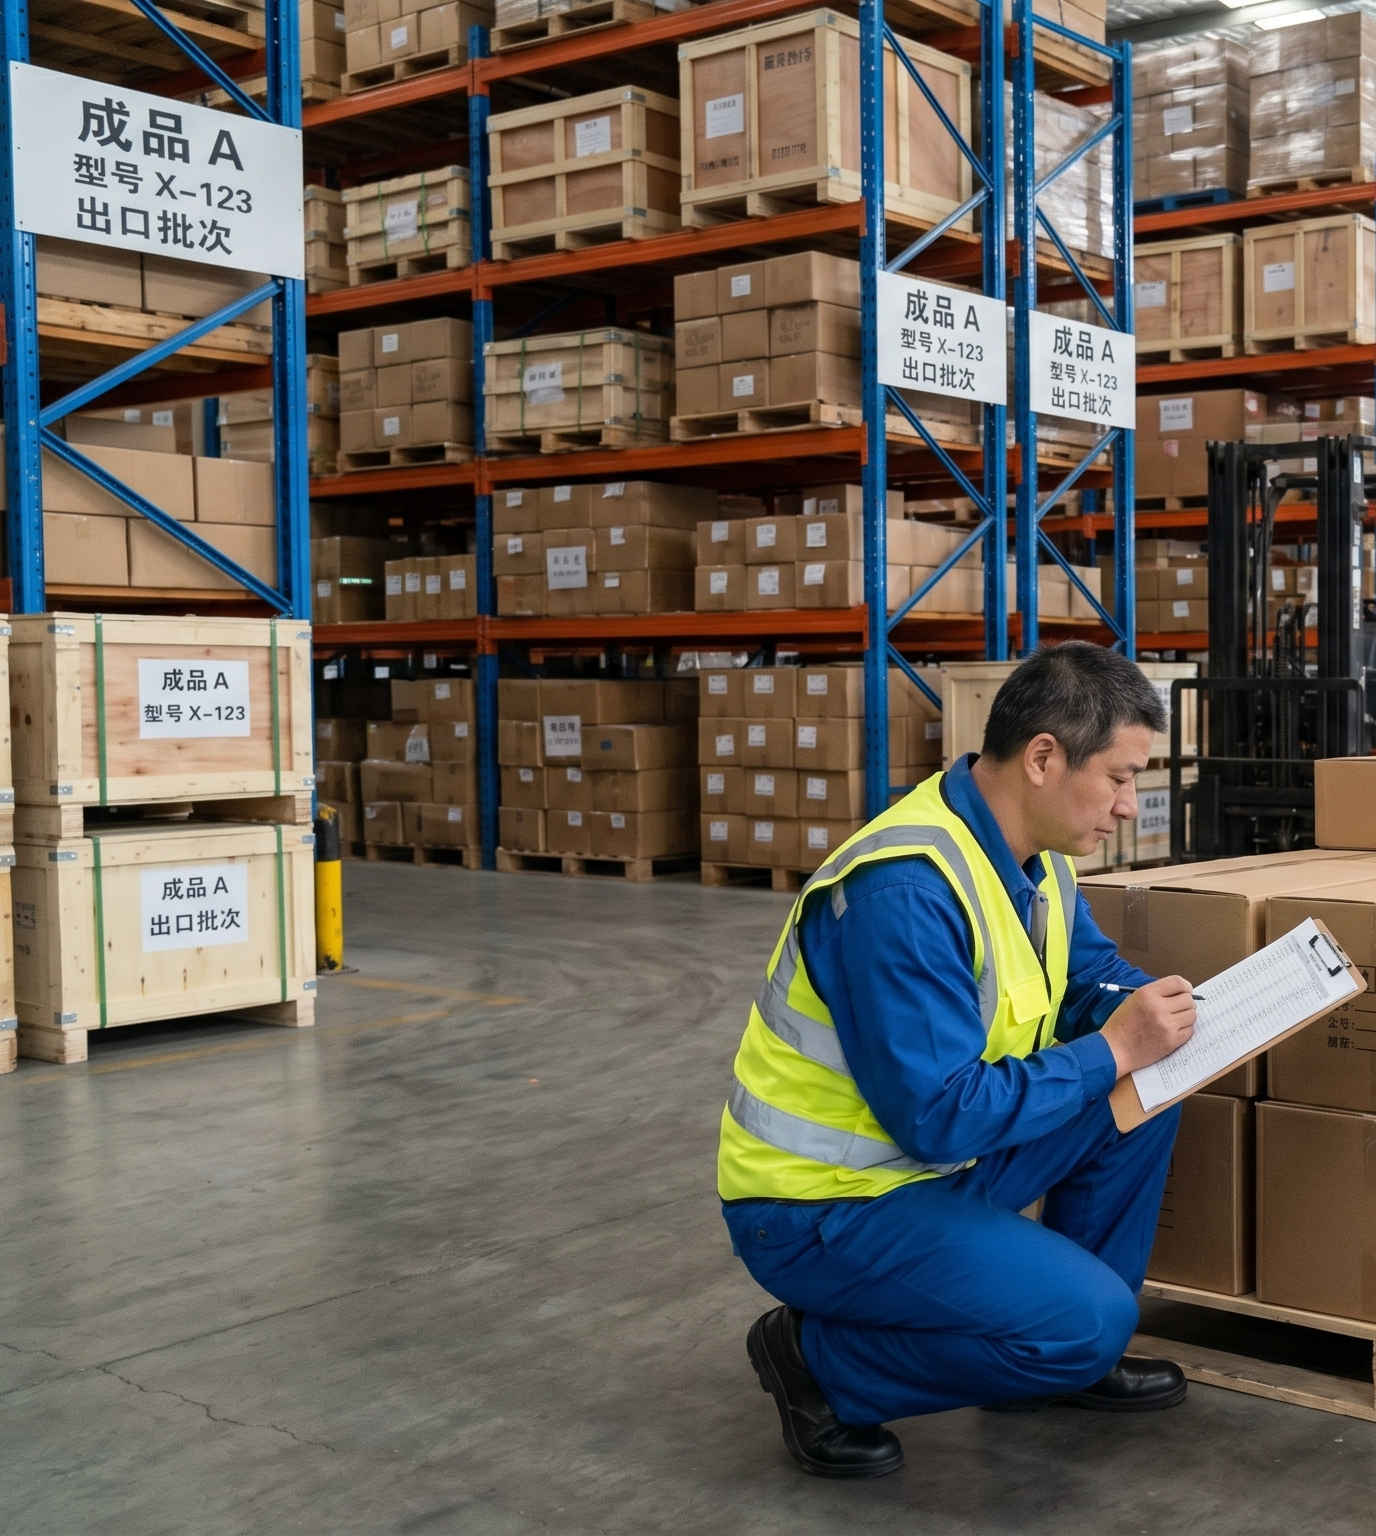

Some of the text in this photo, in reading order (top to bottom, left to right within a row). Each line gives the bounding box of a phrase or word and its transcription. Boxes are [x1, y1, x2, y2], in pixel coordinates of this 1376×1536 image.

[77, 97, 245, 172] 成品 A
[73, 153, 253, 214] 型号 X-123
[76, 196, 233, 256] 出口批次
[904, 289, 981, 332] 成品 A
[900, 328, 984, 362] 型号 X-123
[1053, 325, 1115, 364] 成品 A
[902, 356, 976, 392] 出口批次
[1050, 360, 1118, 391] 型号 X-123
[1051, 386, 1112, 417] 出口批次
[162, 668, 229, 691] 成品 A
[144, 704, 245, 723] 型号 X-123
[162, 876, 229, 900] 成品 A
[150, 908, 241, 936] 出口批次
